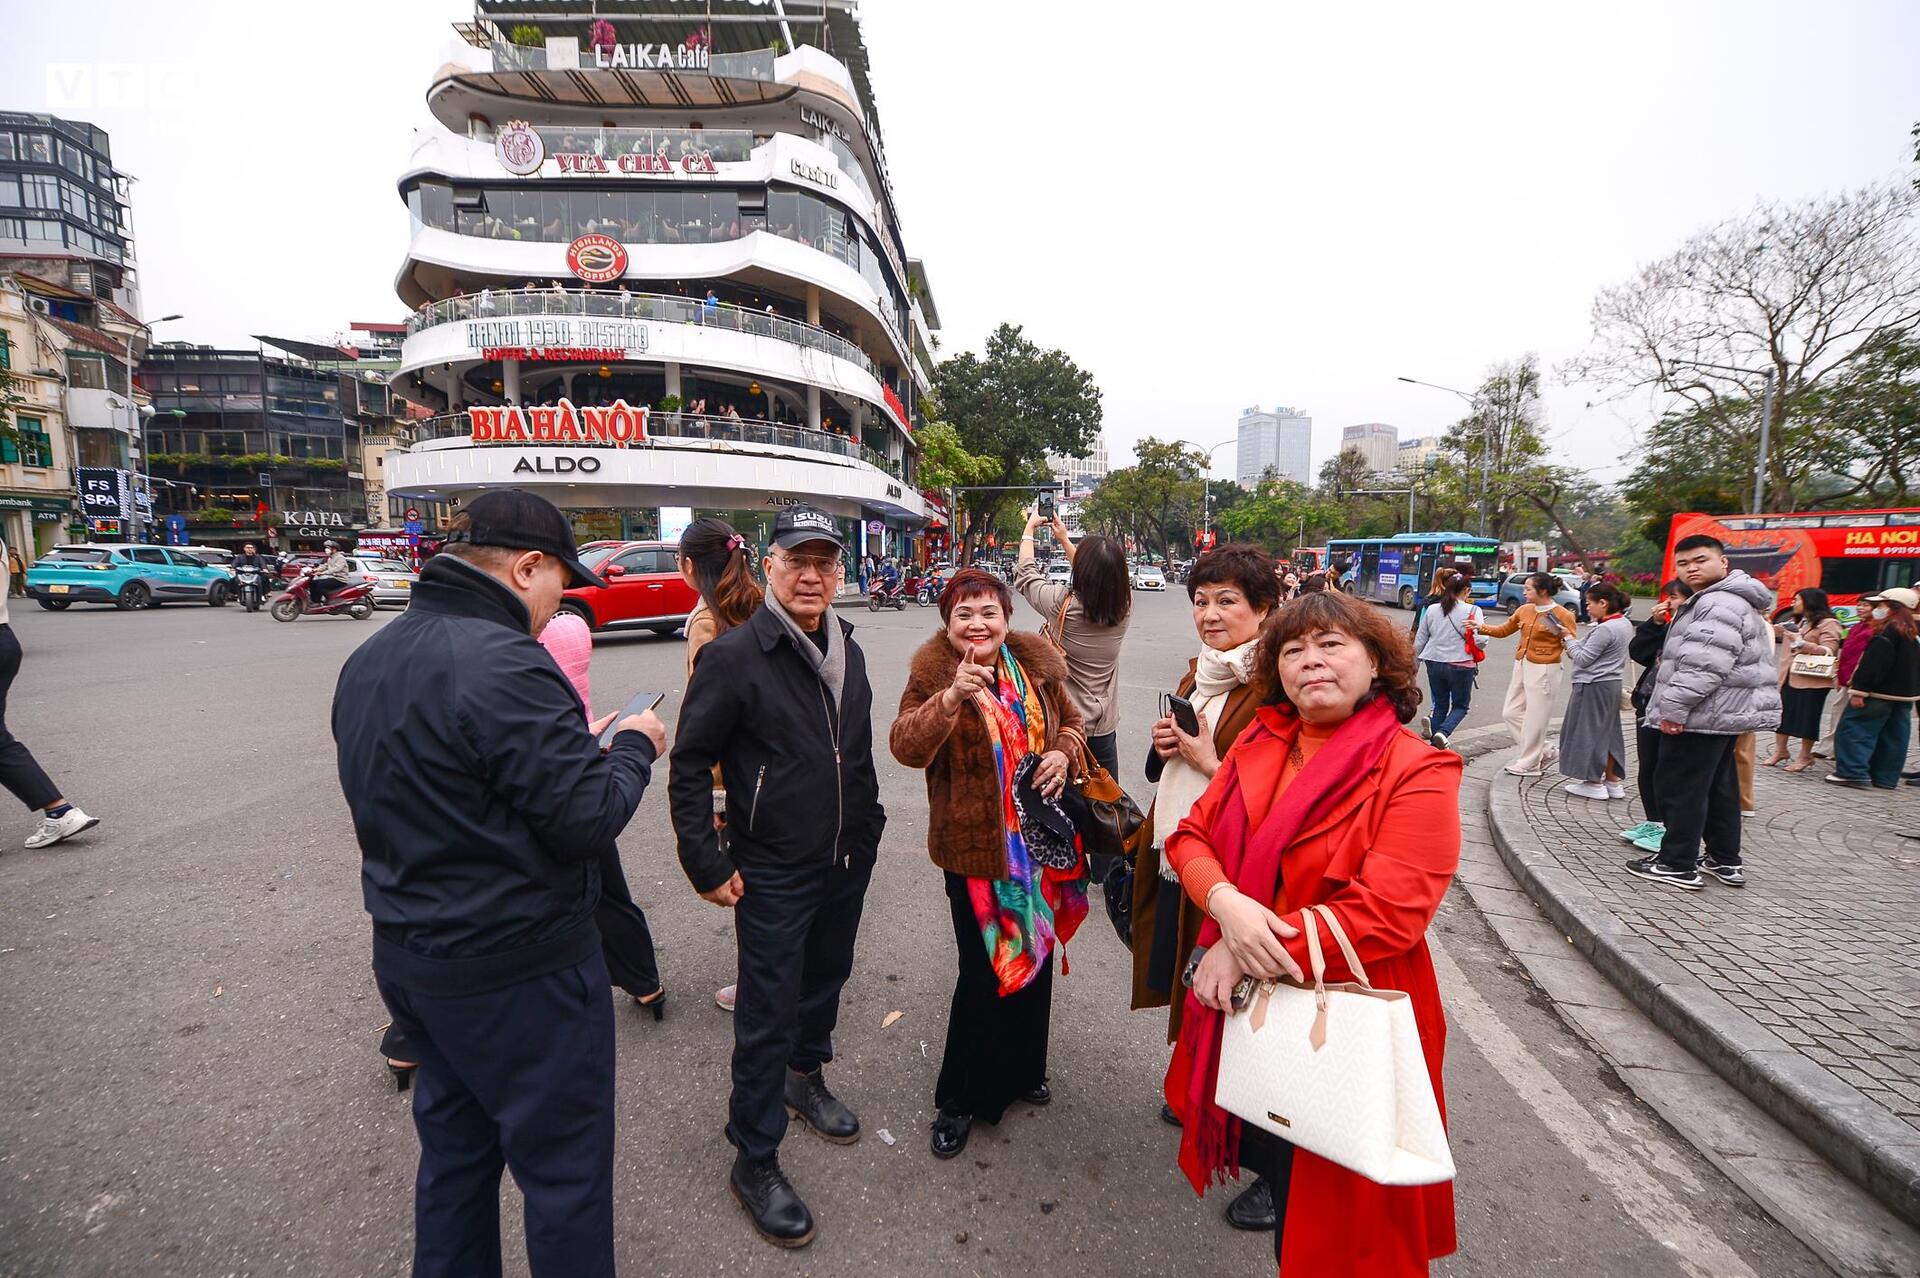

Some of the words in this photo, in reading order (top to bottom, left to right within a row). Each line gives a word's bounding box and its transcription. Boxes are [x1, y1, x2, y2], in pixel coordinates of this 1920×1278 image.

[595, 43, 675, 68] LAIKA
[677, 43, 709, 68] Café
[800, 104, 841, 138] LAIKA
[552, 152, 610, 174] VUA
[569, 236, 624, 257] HIGHLANDS
[577, 267, 618, 280] COFFEE
[466, 320, 521, 348] HANOI
[525, 319, 571, 346] 1930
[579, 320, 649, 350] BISTRO
[482, 347, 527, 361] COFFEE
[543, 347, 625, 361] RESTAURANT
[468, 406, 530, 442] BIA
[529, 398, 583, 442] HÀ
[582, 399, 649, 449] NỘI
[513, 456, 601, 474] ALDO
[87, 480, 110, 491] FS
[886, 483, 902, 499] ALDO
[84, 494, 118, 506] SPA
[766, 497, 799, 506] ALDO
[38, 512, 57, 520] ATM
[282, 510, 345, 526] KAFA
[793, 512, 833, 526] ISUZU
[299, 527, 330, 537] Café
[1846, 531, 1875, 545] HA
[1880, 530, 1919, 544] NOI
